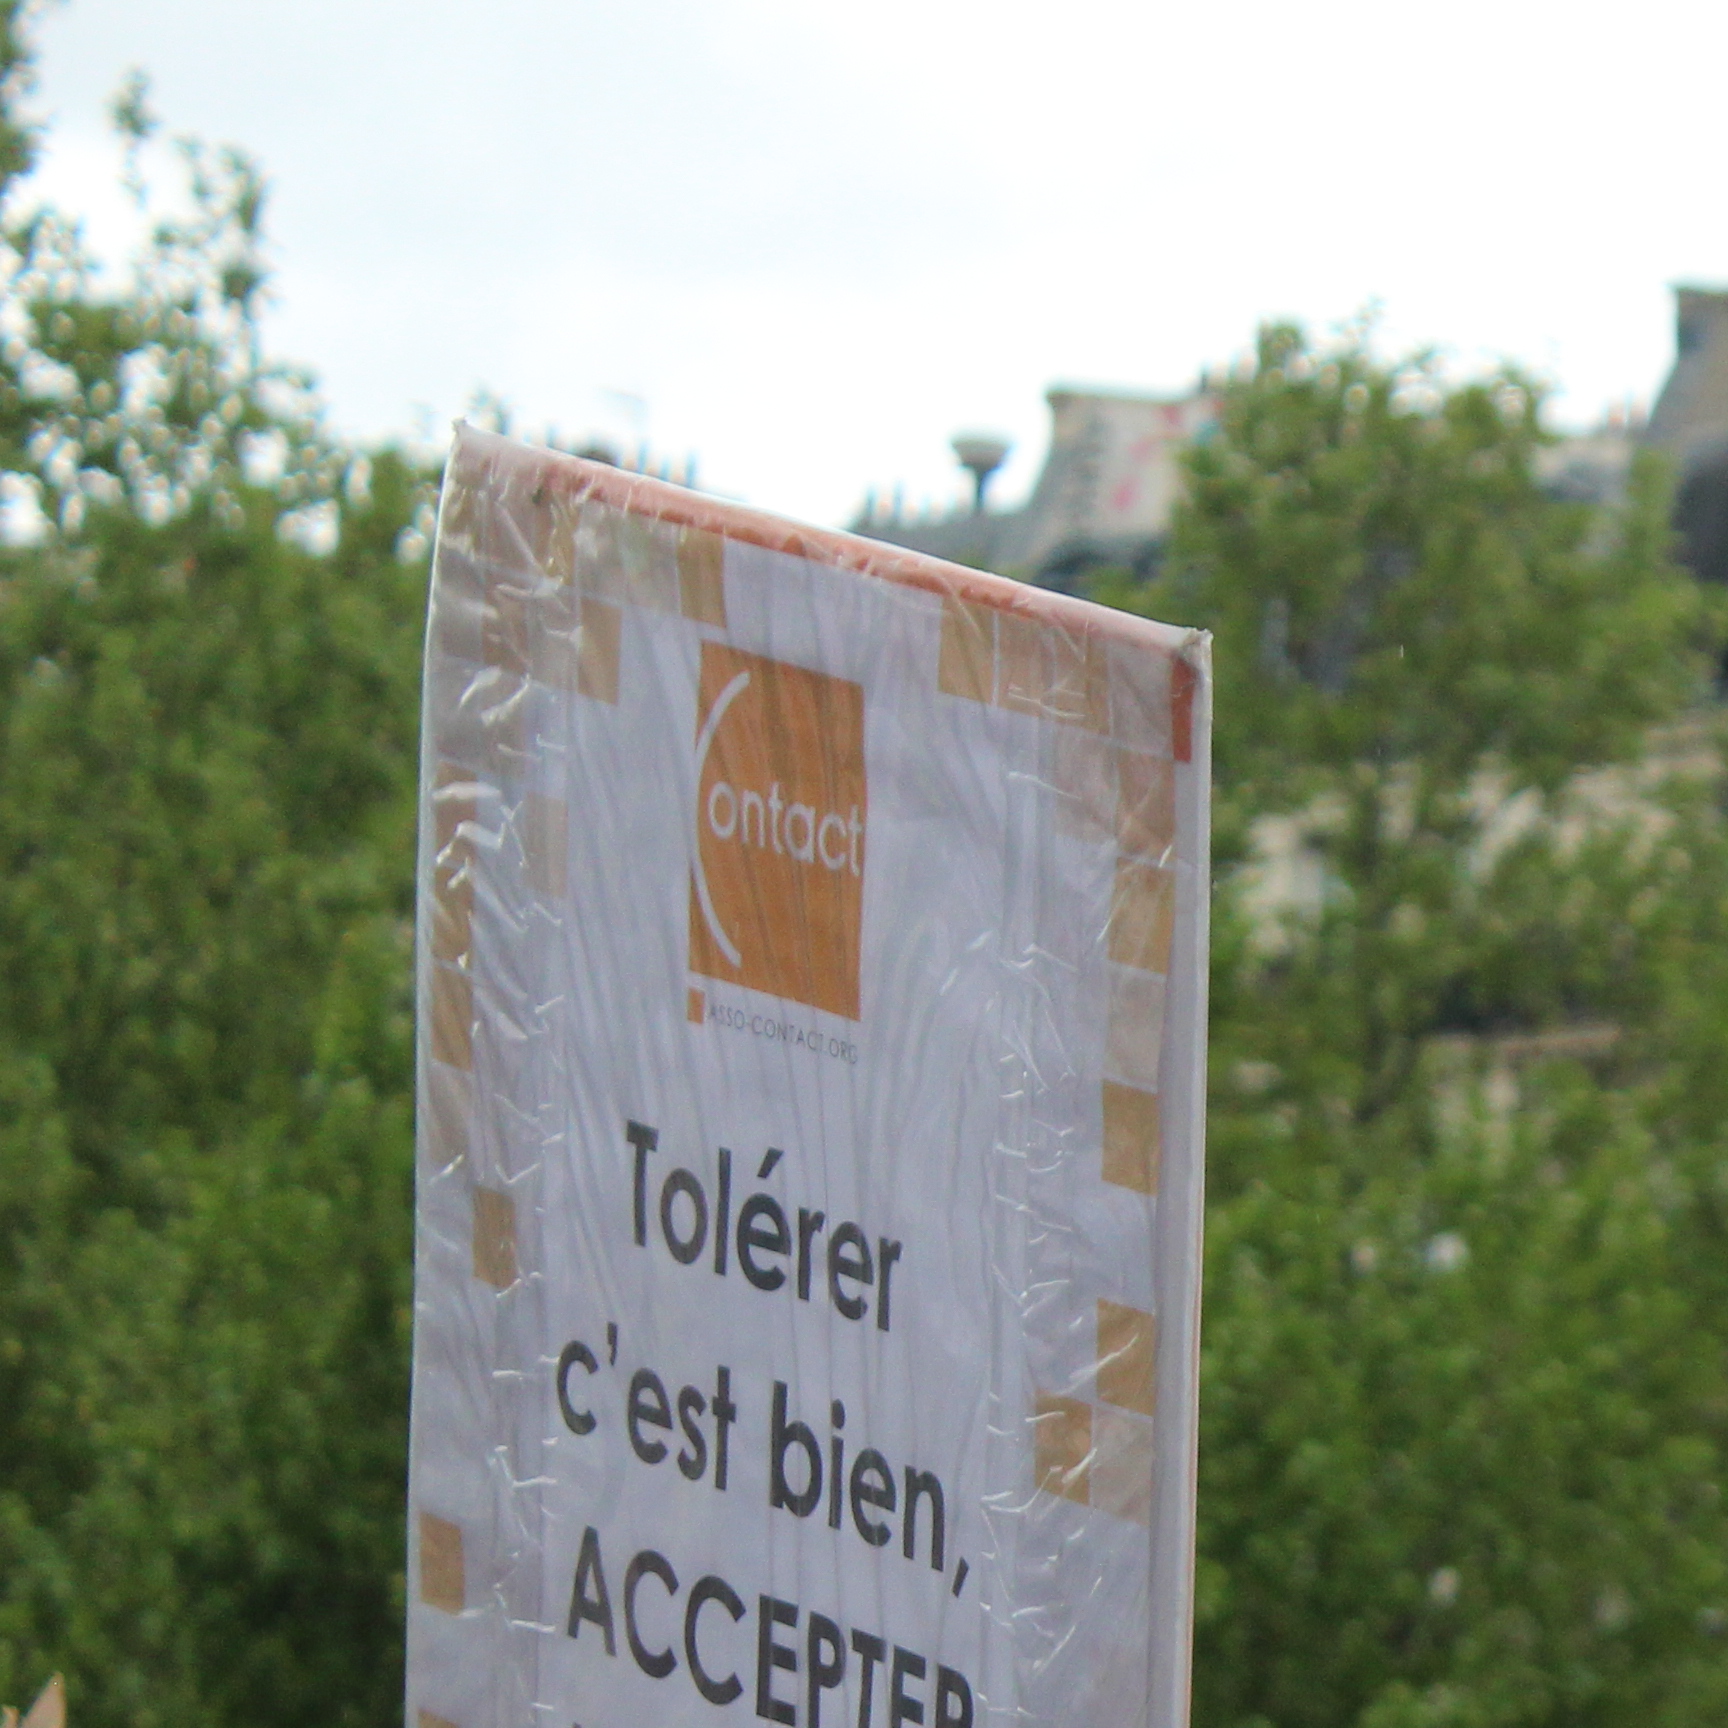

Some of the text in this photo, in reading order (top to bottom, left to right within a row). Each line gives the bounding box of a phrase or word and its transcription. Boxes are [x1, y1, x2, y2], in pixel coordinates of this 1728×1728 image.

[625, 1120, 902, 1333] Tolérer
[555, 1321, 971, 1598] c'est bien,
